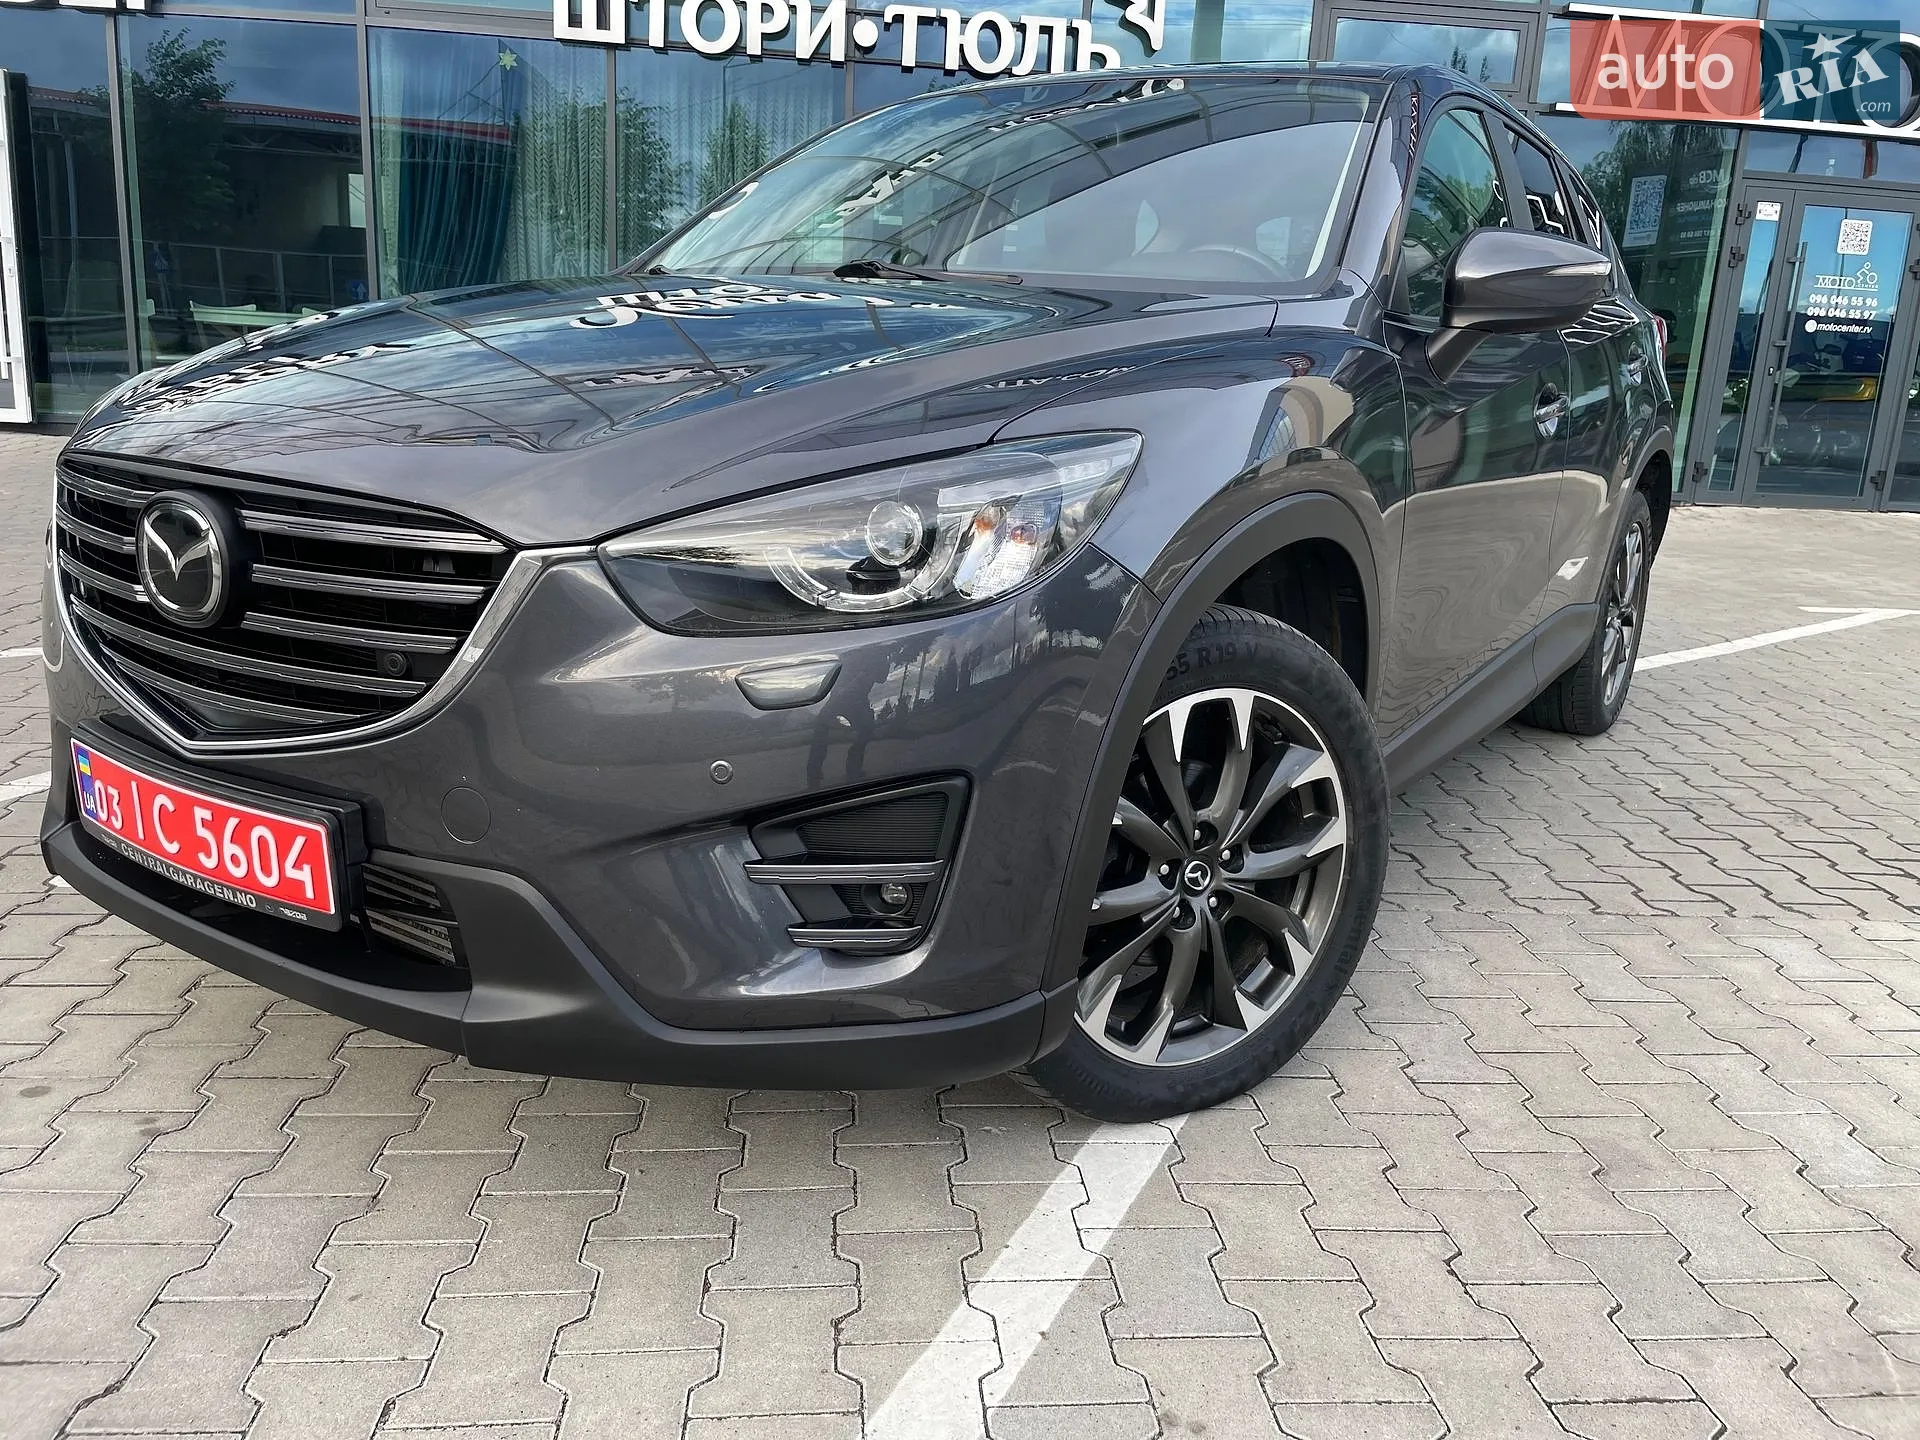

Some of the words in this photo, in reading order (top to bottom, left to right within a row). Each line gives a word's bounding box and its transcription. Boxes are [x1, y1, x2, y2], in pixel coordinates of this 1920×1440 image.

[1809, 293, 1828, 304] 096
[1830, 295, 1849, 306] 046
[1851, 296, 1864, 306] 55
[1865, 298, 1878, 308] 96
[1807, 306, 1826, 317] 096
[1827, 308, 1847, 318] 046
[1848, 309, 1861, 319] 55
[1863, 310, 1877, 320] 97
[83, 790, 97, 814] UA
[93, 779, 124, 831] 03
[193, 805, 315, 900] 5604
[121, 843, 257, 909] CENTRALGARAGEN.NO
